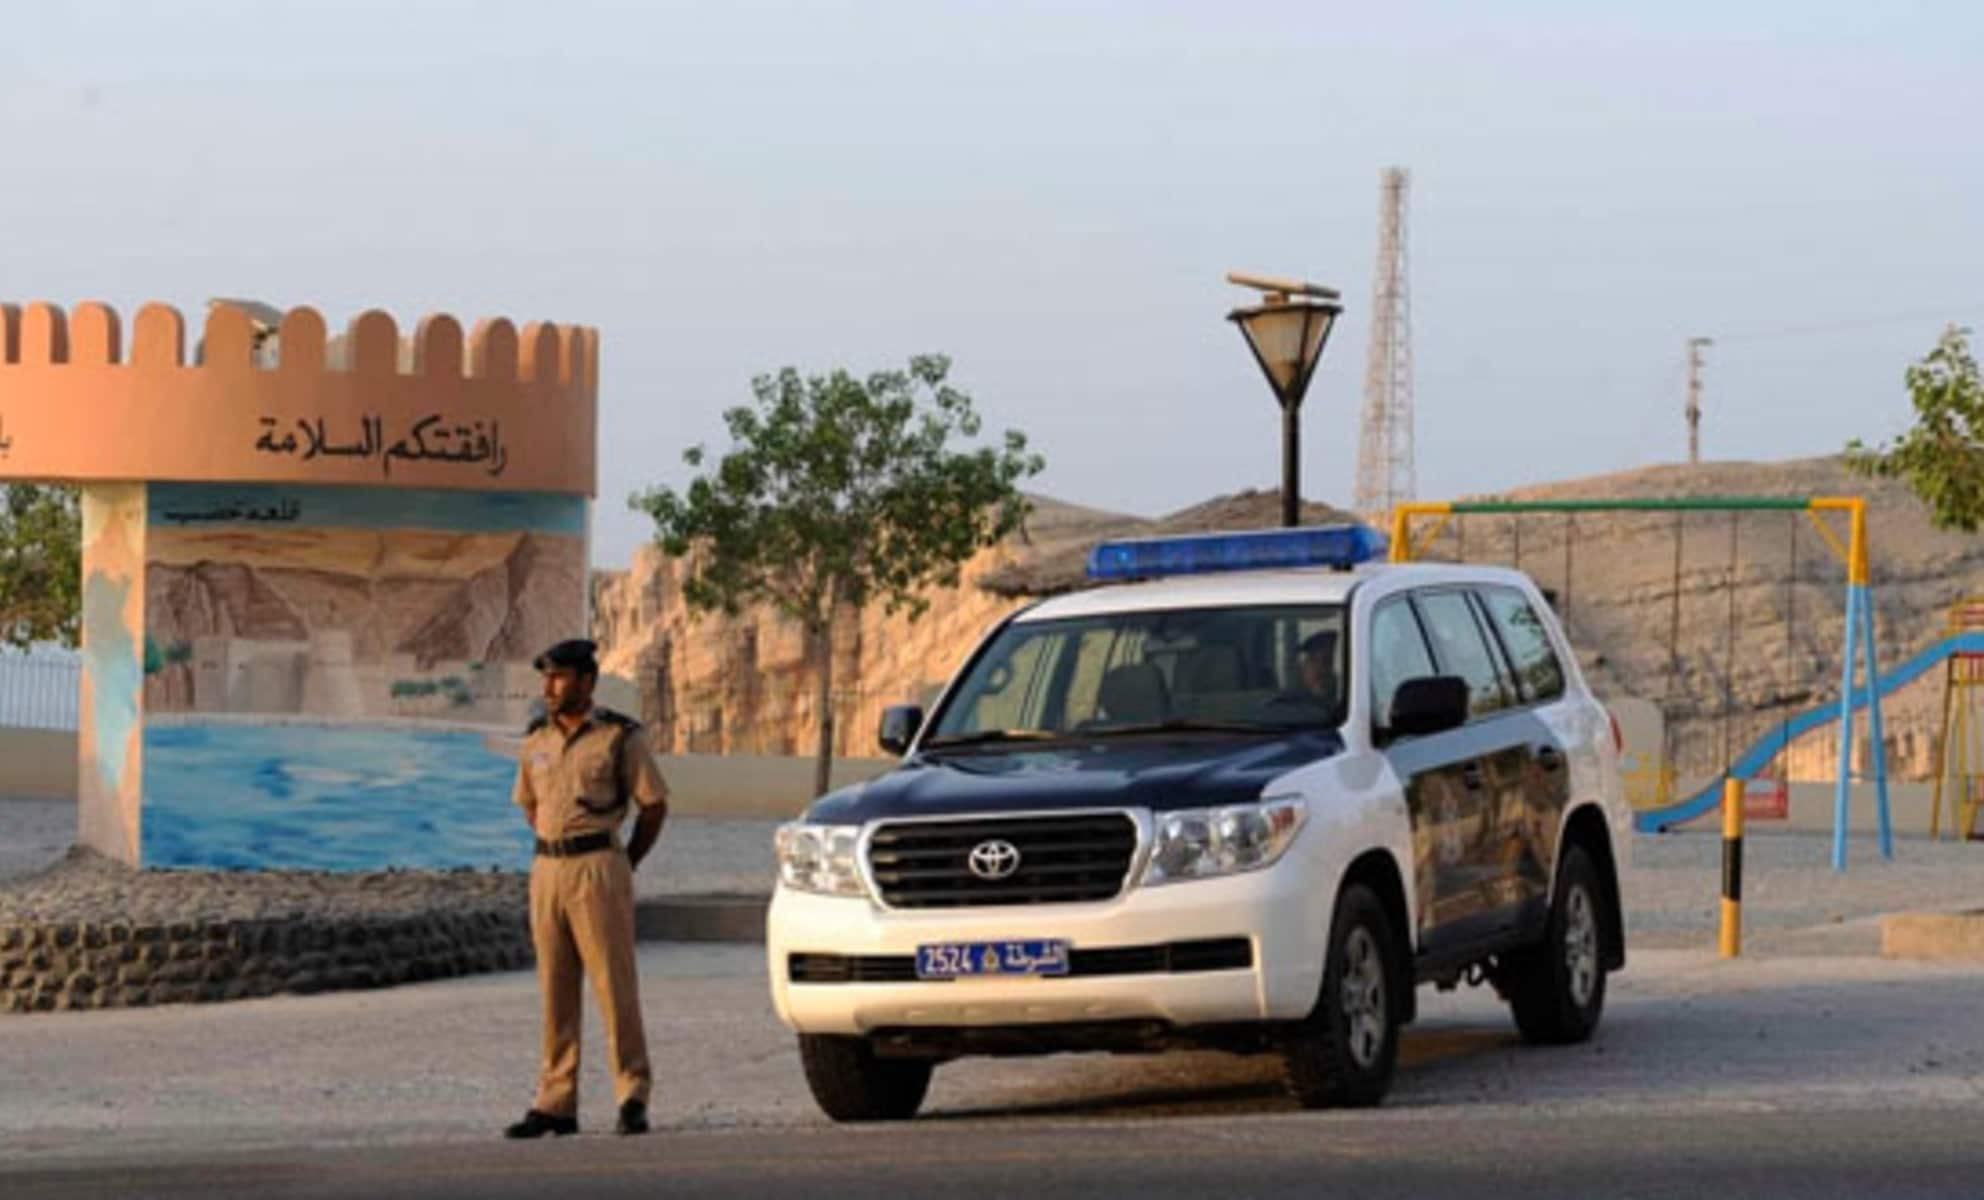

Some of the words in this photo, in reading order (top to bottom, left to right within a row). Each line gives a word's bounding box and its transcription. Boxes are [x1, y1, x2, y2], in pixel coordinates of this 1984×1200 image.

[255, 414, 381, 460] السلامة
[383, 413, 507, 477] رافقتكم
[923, 945, 974, 974] 2524
